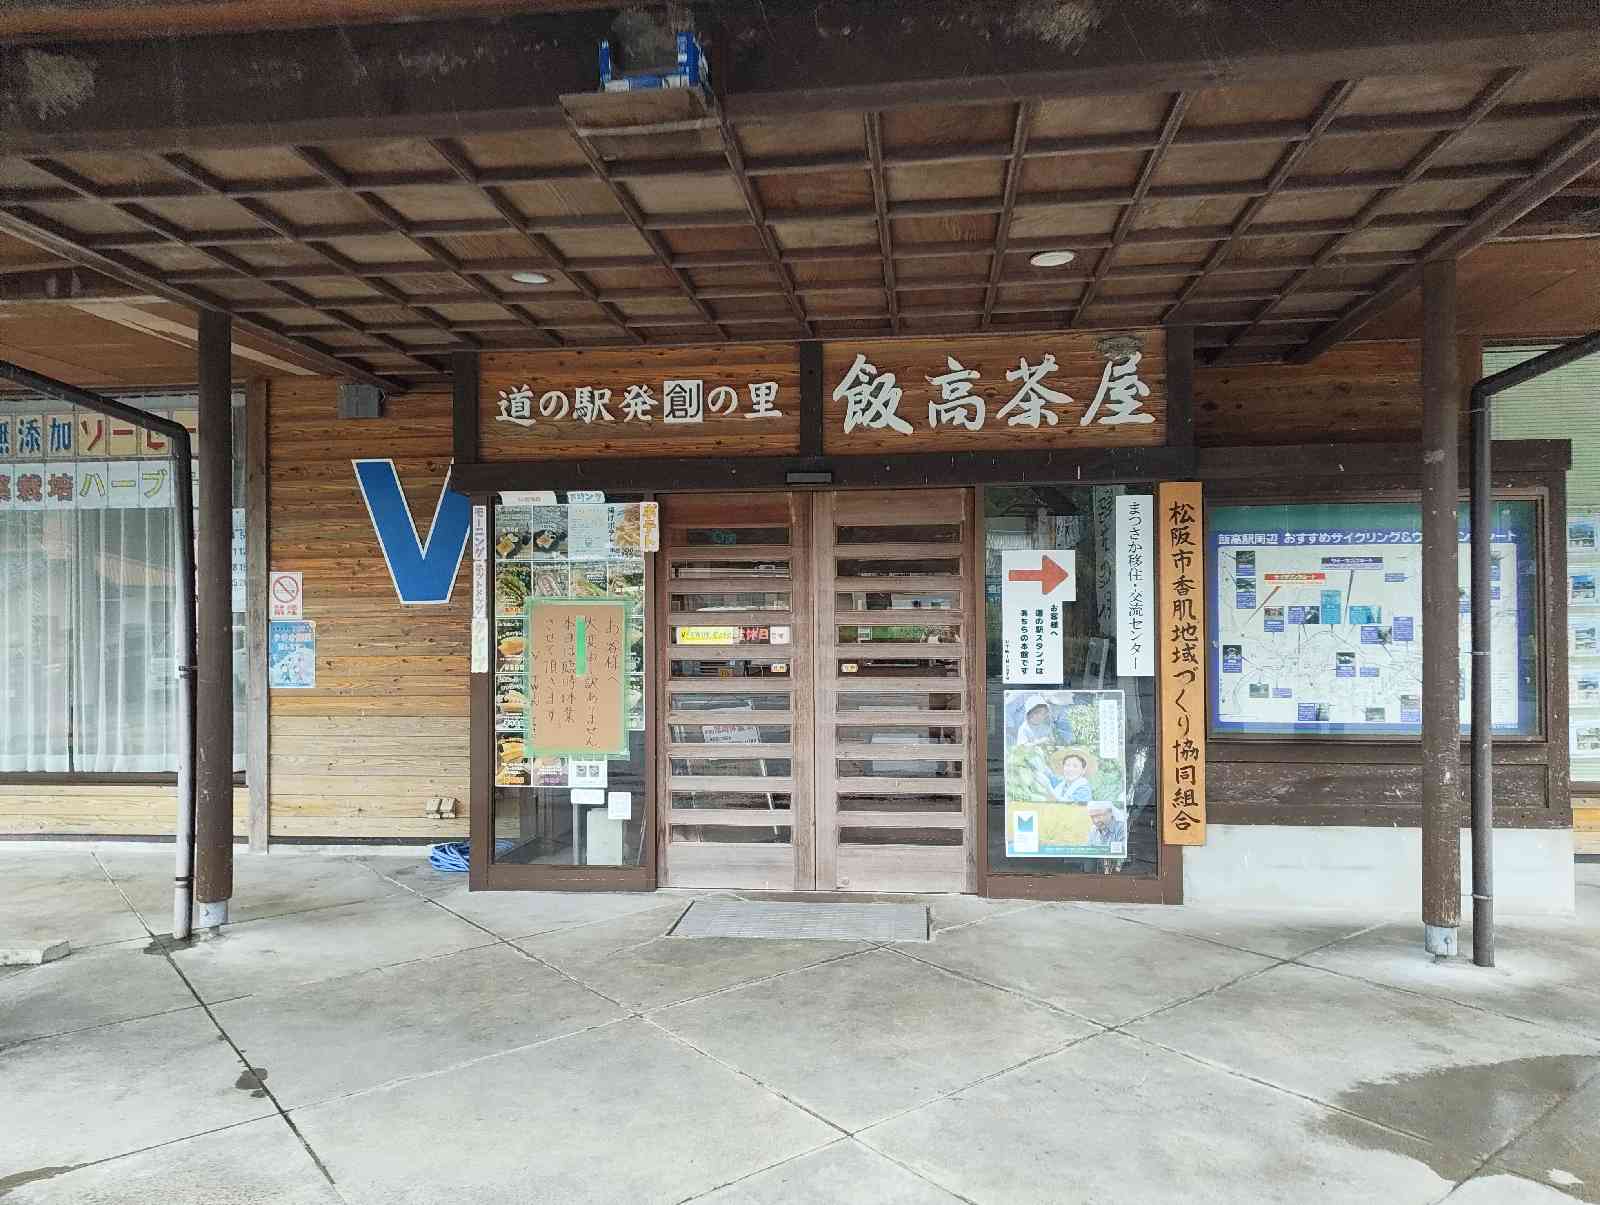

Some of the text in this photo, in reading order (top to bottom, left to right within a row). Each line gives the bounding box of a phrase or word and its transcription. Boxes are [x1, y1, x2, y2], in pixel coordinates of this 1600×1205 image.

[495, 380, 783, 425] 道の駅発創の里
[832, 352, 1156, 435] 飯高茶屋
[1127, 501, 1145, 670] まつさか移住・交流センター
[1168, 501, 1200, 831] 松阪市香肌地域づくり協同組合
